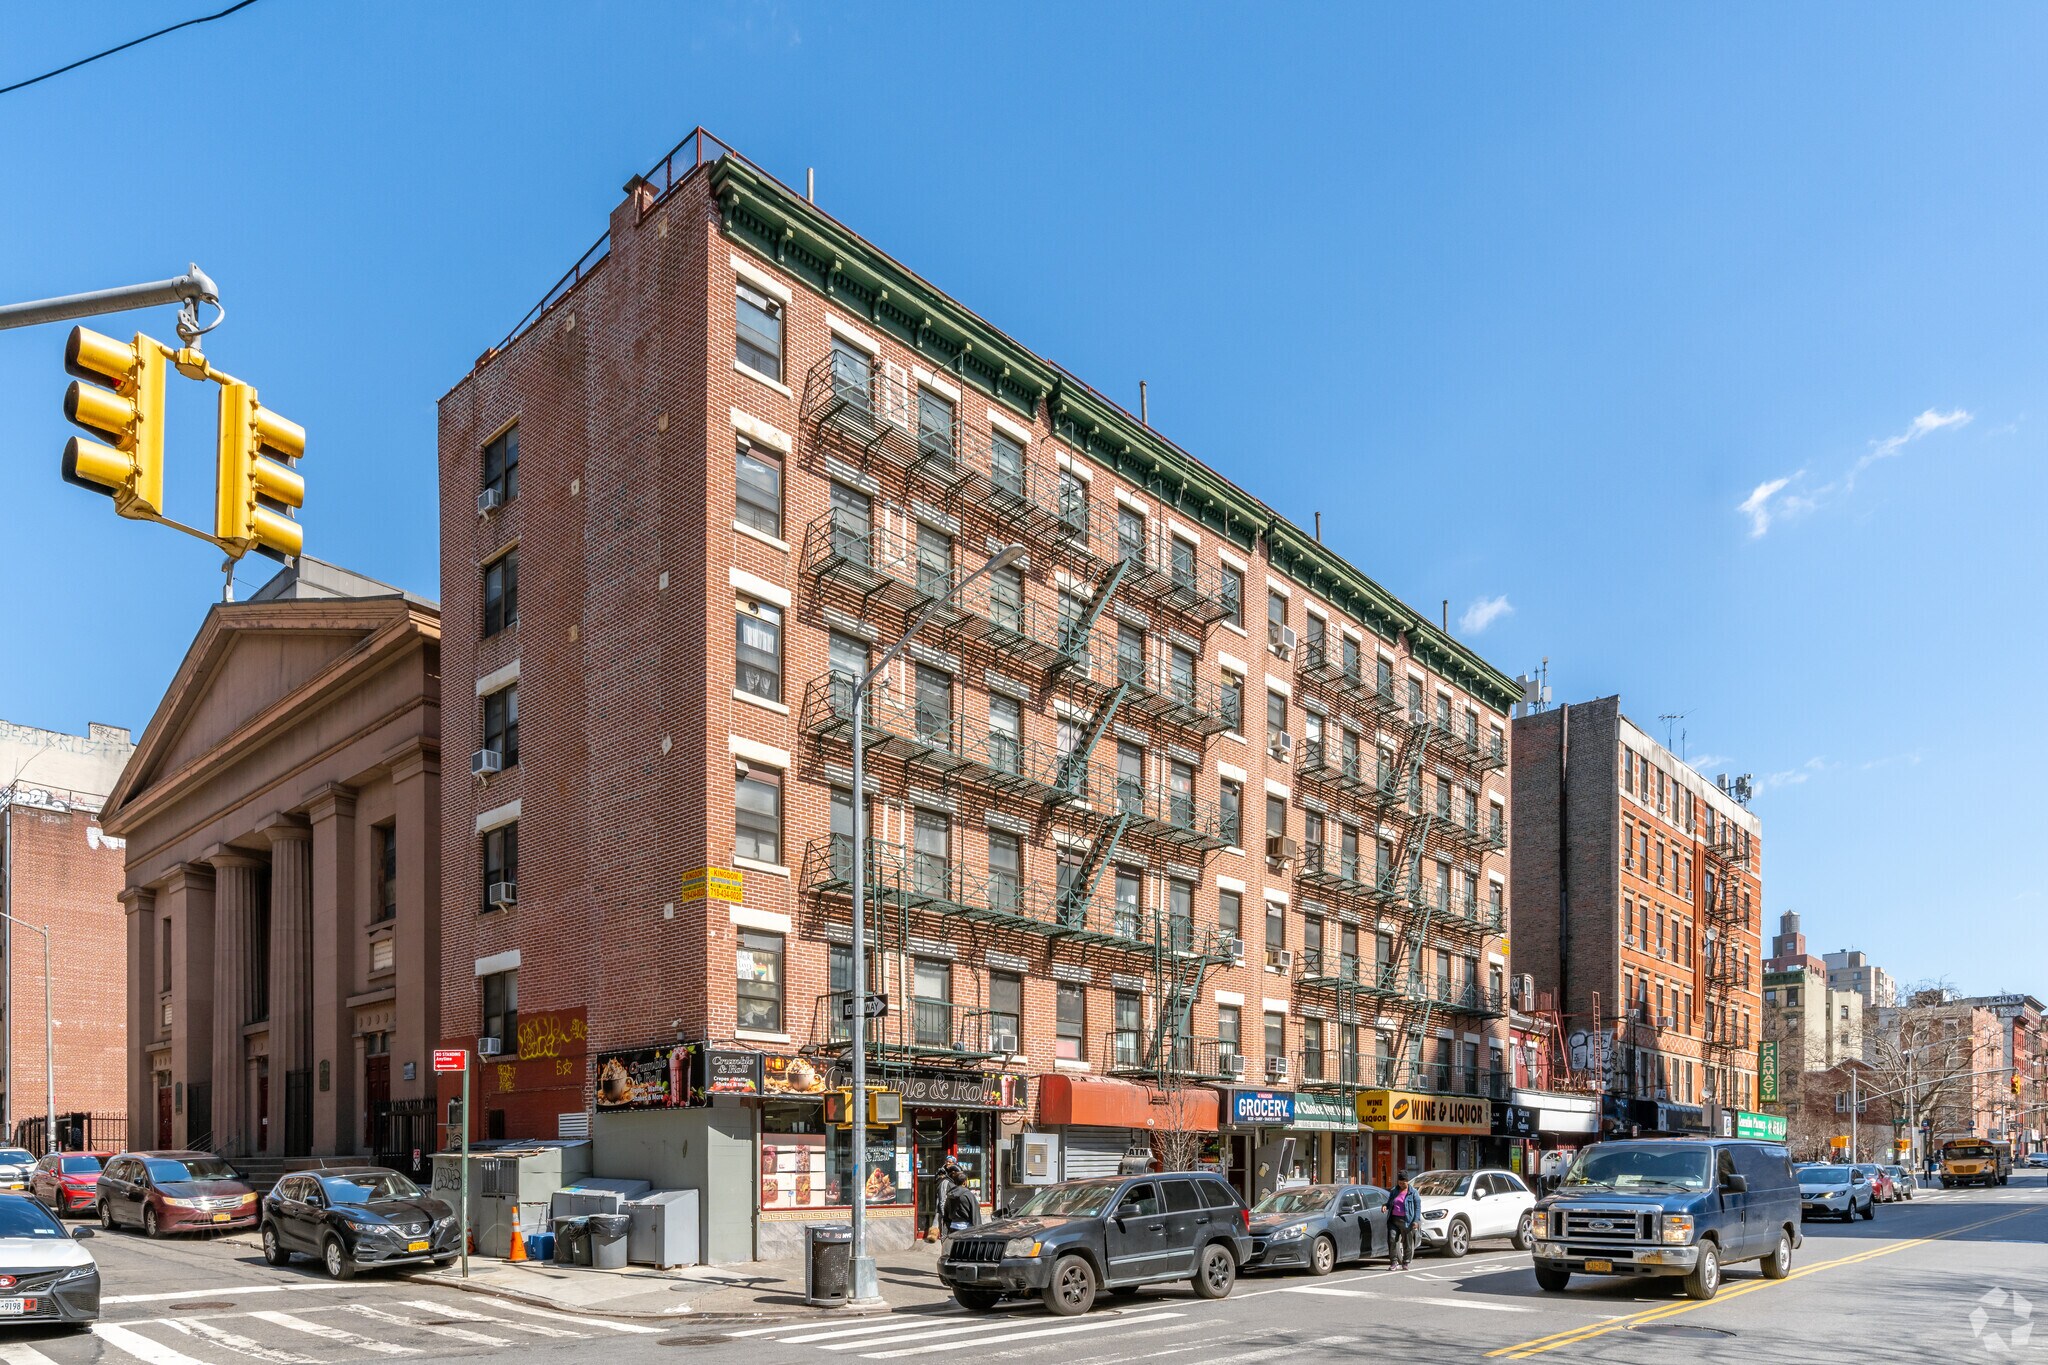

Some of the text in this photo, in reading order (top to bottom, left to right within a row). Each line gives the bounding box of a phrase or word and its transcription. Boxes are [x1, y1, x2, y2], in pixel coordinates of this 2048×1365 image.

[713, 869, 739, 881] KINGDOM
[865, 1002, 879, 1012] WAY
[712, 1056, 754, 1066] Crumble
[728, 1065, 748, 1074] Roll
[1763, 1042, 1775, 1094] PHARMACY
[929, 1074, 949, 1100] &
[951, 1075, 995, 1102] Roll
[1239, 1098, 1287, 1116] GROCERY
[1411, 1100, 1436, 1120] WINE
[1439, 1102, 1446, 1120] &
[1449, 1103, 1483, 1125] LIQUOR
[1129, 1148, 1148, 1156] ATM
